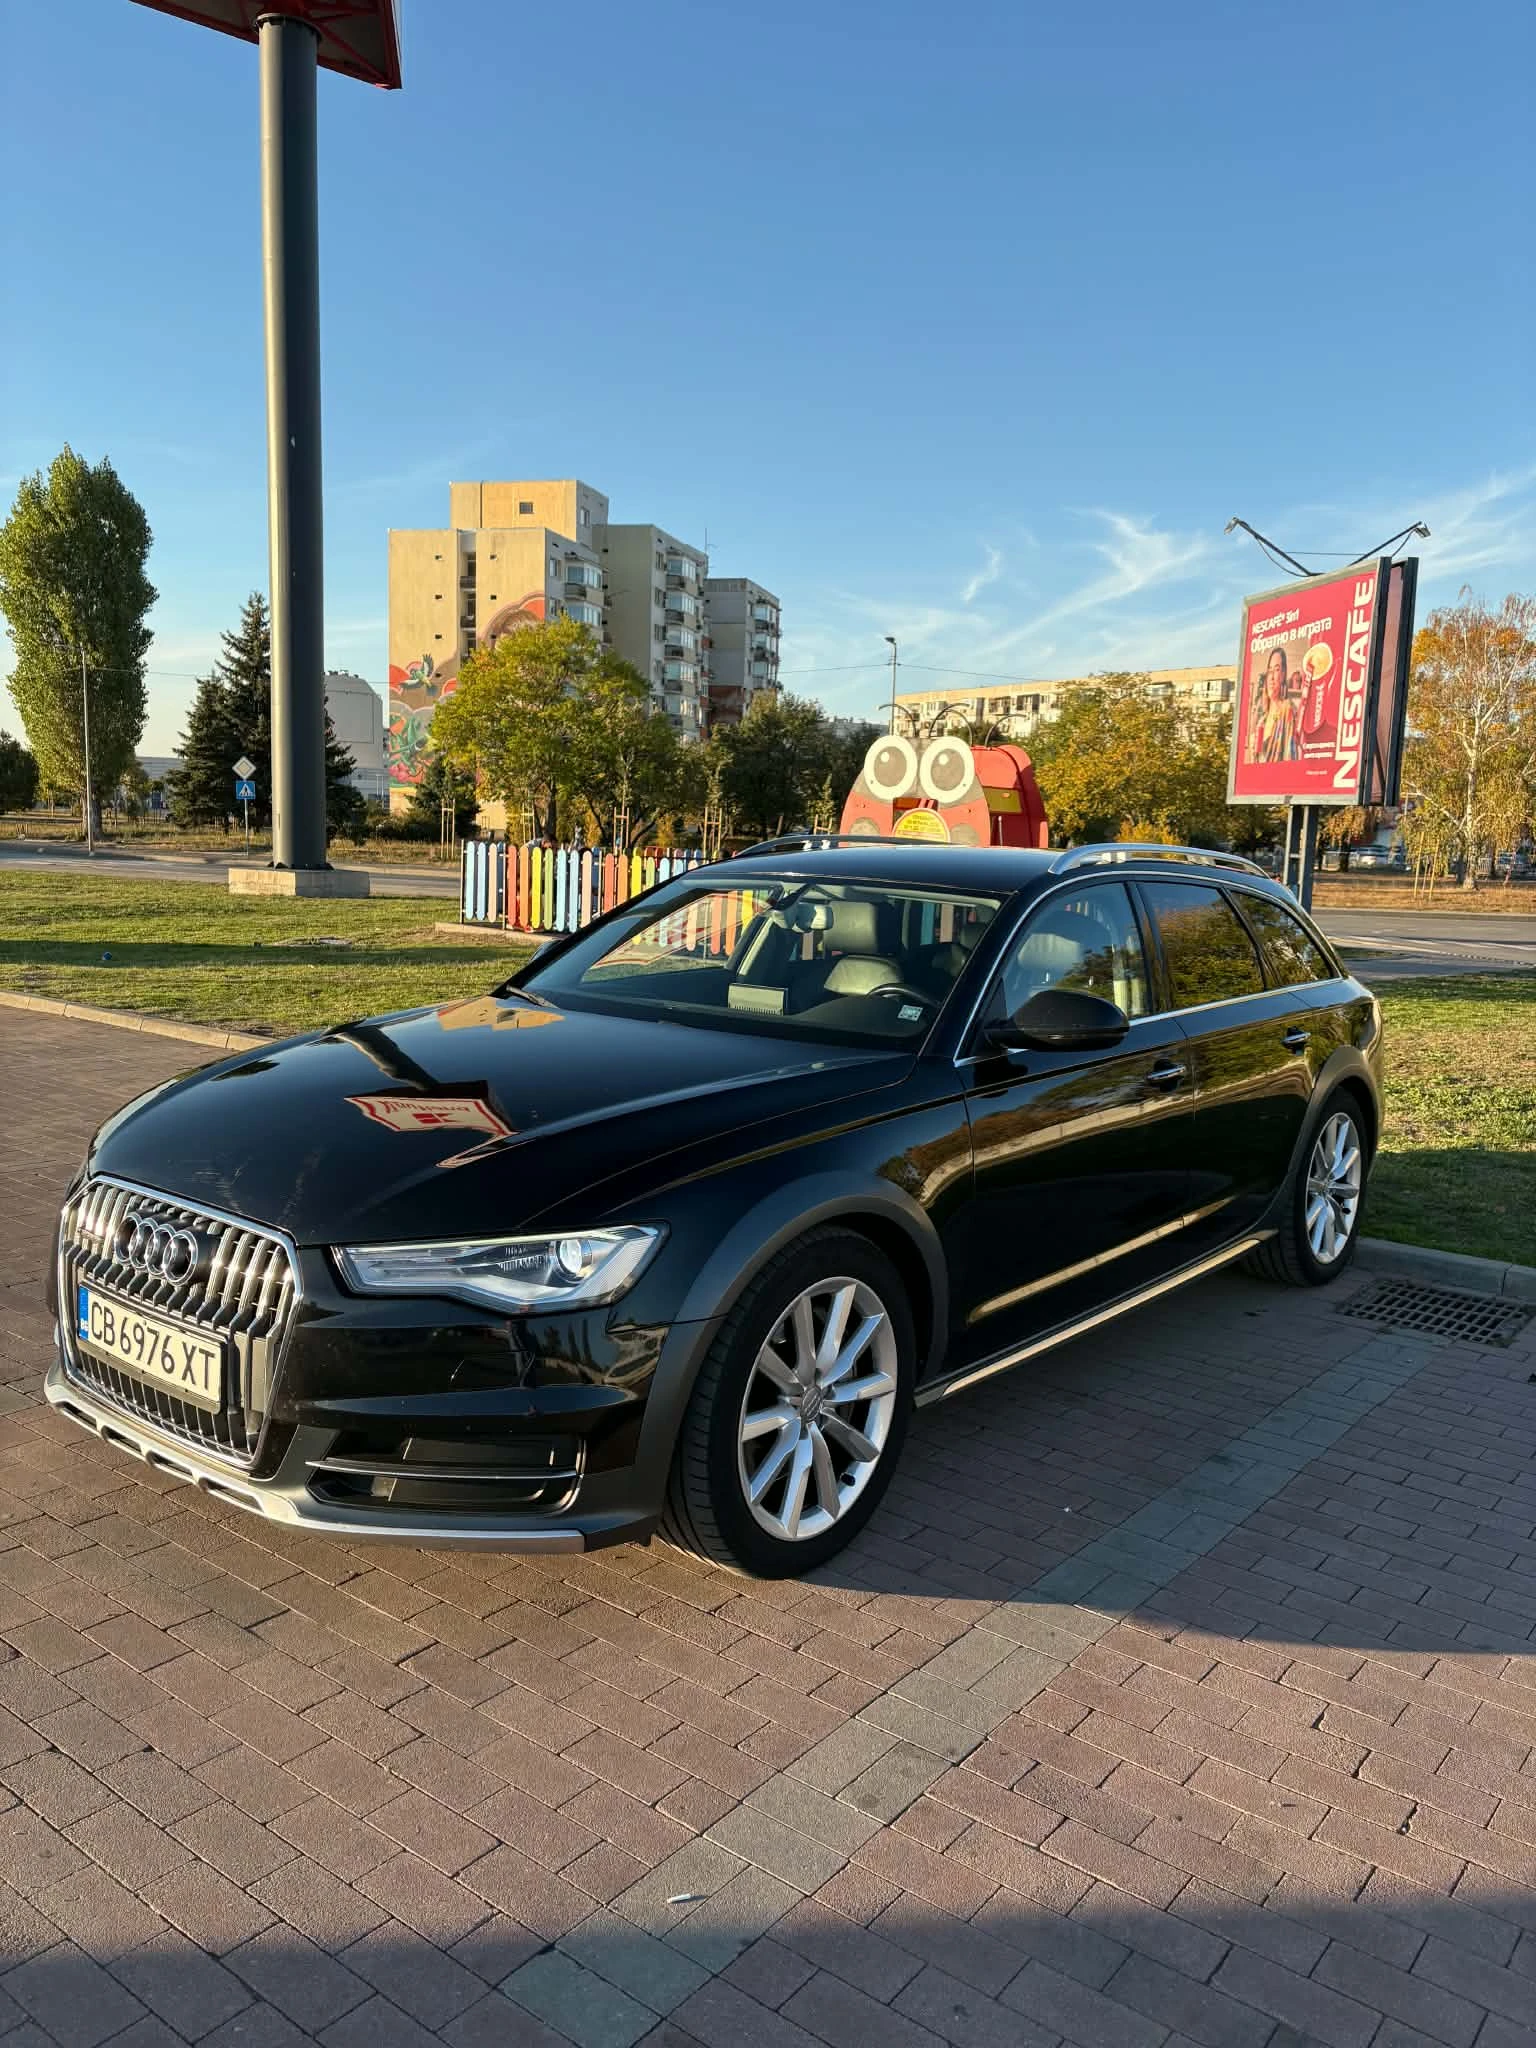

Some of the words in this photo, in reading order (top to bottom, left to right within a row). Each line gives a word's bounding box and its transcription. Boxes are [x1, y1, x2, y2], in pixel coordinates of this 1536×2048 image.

[1251, 631, 1289, 654] Обратно
[1289, 628, 1297, 641] в
[1297, 616, 1332, 639] играта
[1285, 608, 1300, 624] 3in1
[120, 1316, 175, 1374] 6976
